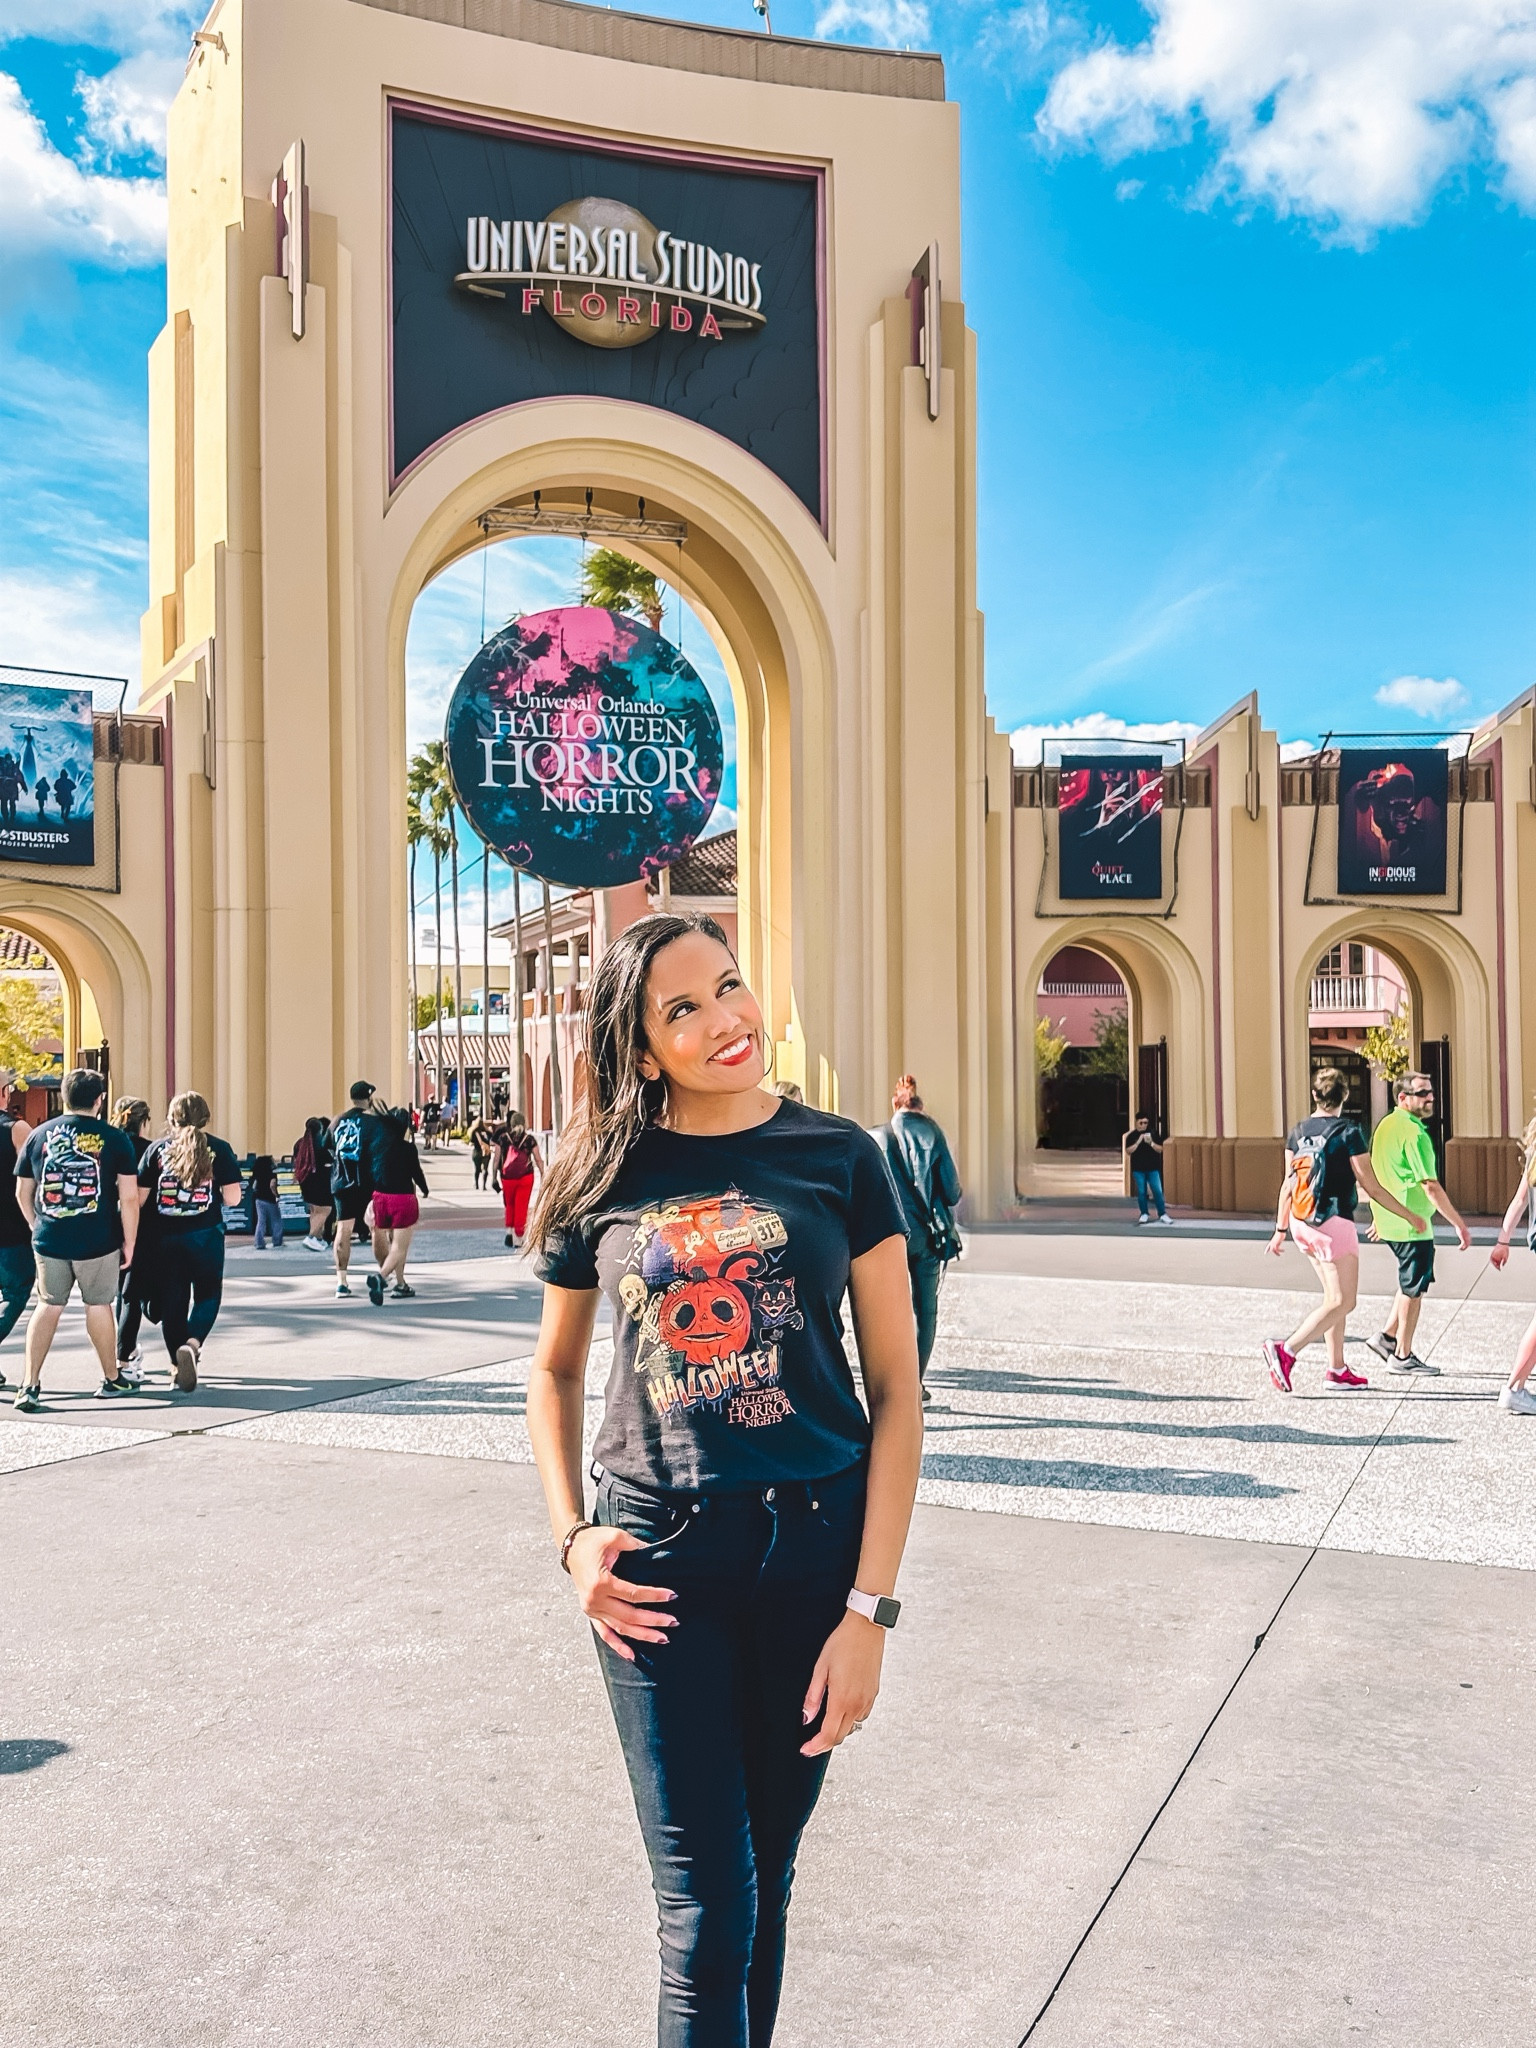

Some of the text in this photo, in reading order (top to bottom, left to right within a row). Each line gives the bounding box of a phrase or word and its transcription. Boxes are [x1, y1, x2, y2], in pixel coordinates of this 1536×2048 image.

[466, 216, 762, 312] UNIVERSAL STUDIOS
[521, 288, 723, 341] FLORIDA
[515, 691, 665, 715] Universal Orlando
[492, 709, 686, 743] HALLOWEEN
[477, 738, 706, 803] HORROR
[541, 786, 653, 815] NIGHTS
[0, 840, 26, 848] ROZEN
[1092, 866, 1123, 876] QUIET
[1100, 873, 1132, 884] PLACE
[1369, 867, 1415, 877] INSIDIOUS
[752, 1215, 778, 1225] OCTOBER
[718, 1229, 749, 1241] Everyday
[647, 1344, 779, 1416] HALLOWEEN
[731, 1389, 786, 1407] HALLOWEEN
[727, 1398, 797, 1424] HORROR
[745, 1414, 783, 1429] NIGHTS
